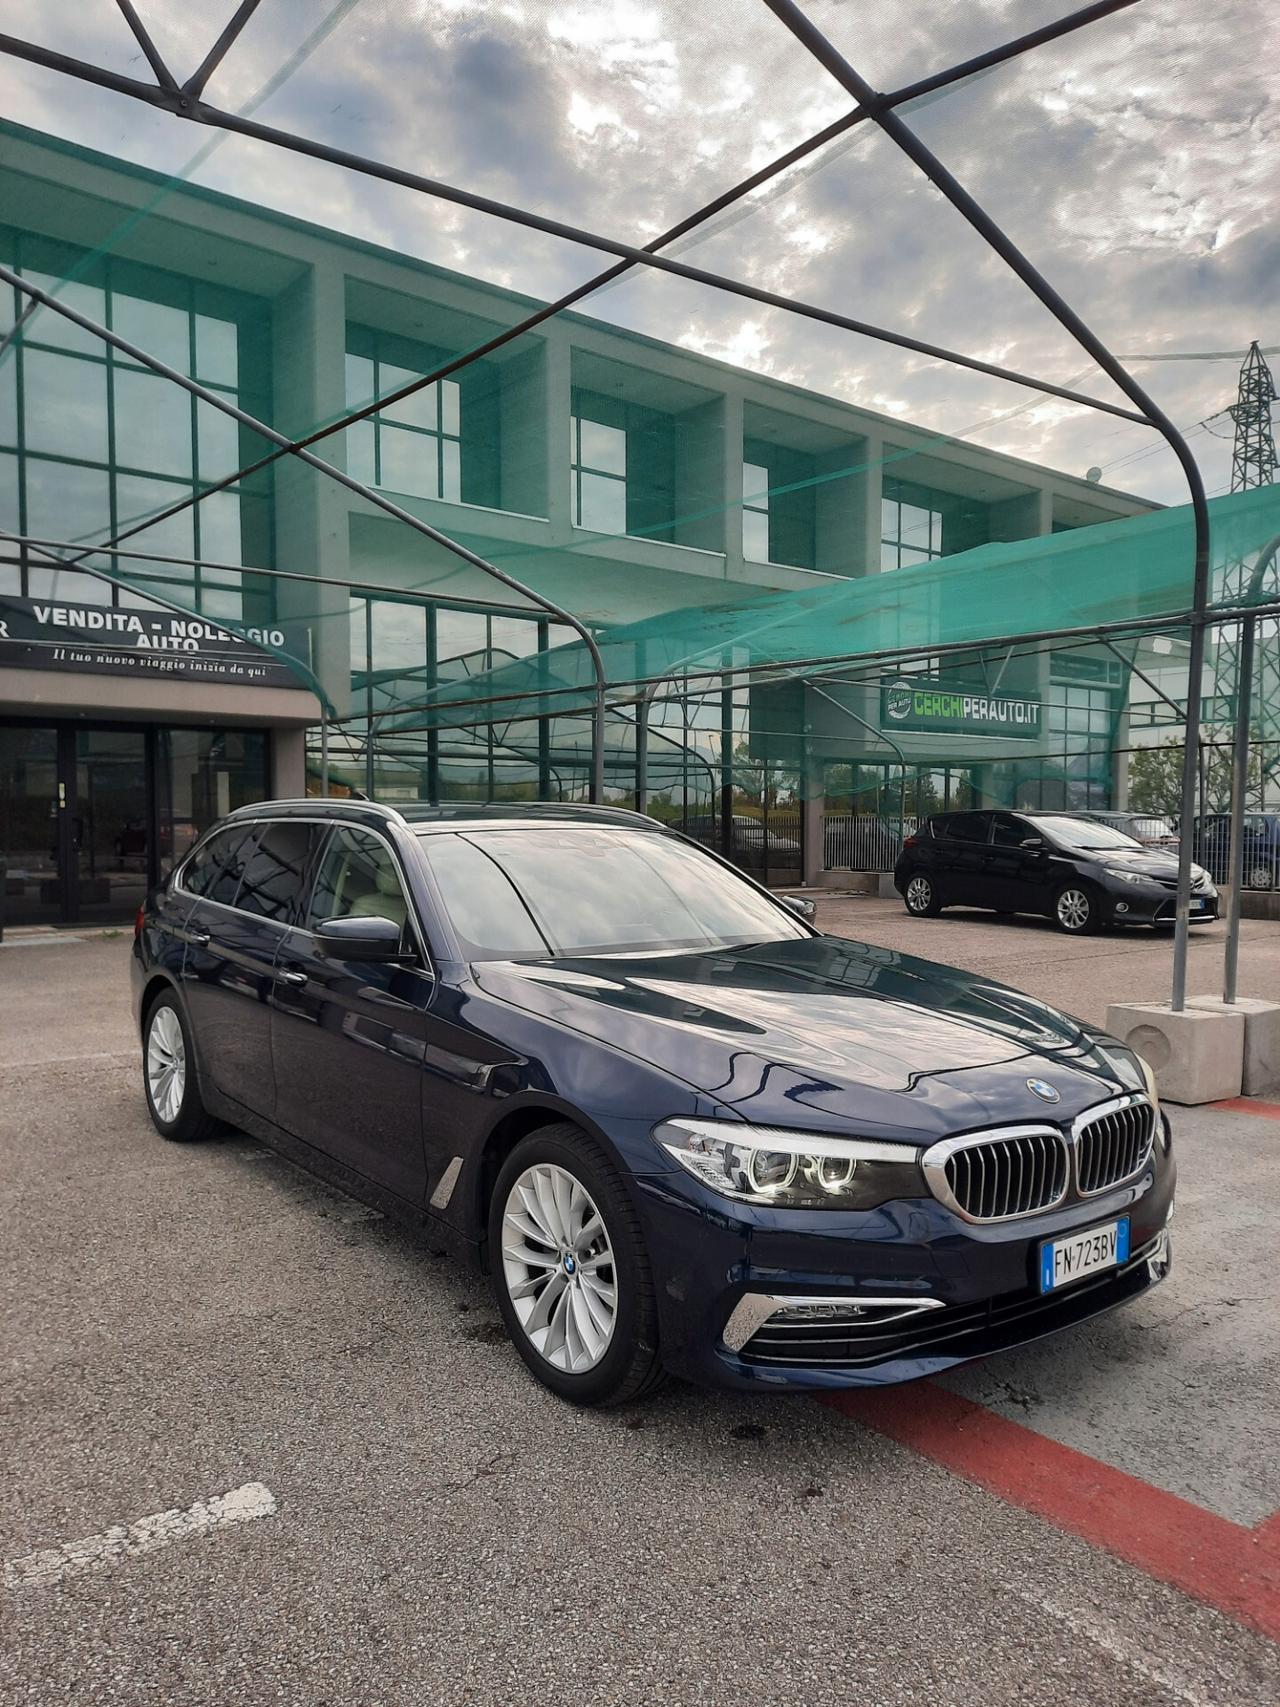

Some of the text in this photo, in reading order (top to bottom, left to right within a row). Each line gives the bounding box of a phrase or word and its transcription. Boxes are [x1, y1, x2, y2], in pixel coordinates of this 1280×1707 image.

[32, 605, 143, 634] VENDITA
[136, 634, 200, 655] AUTO
[53, 648, 267, 678] Il tuo nuovo viaggio inizia da qui
[914, 691, 1040, 724] CERCHIPERAUTO.IT
